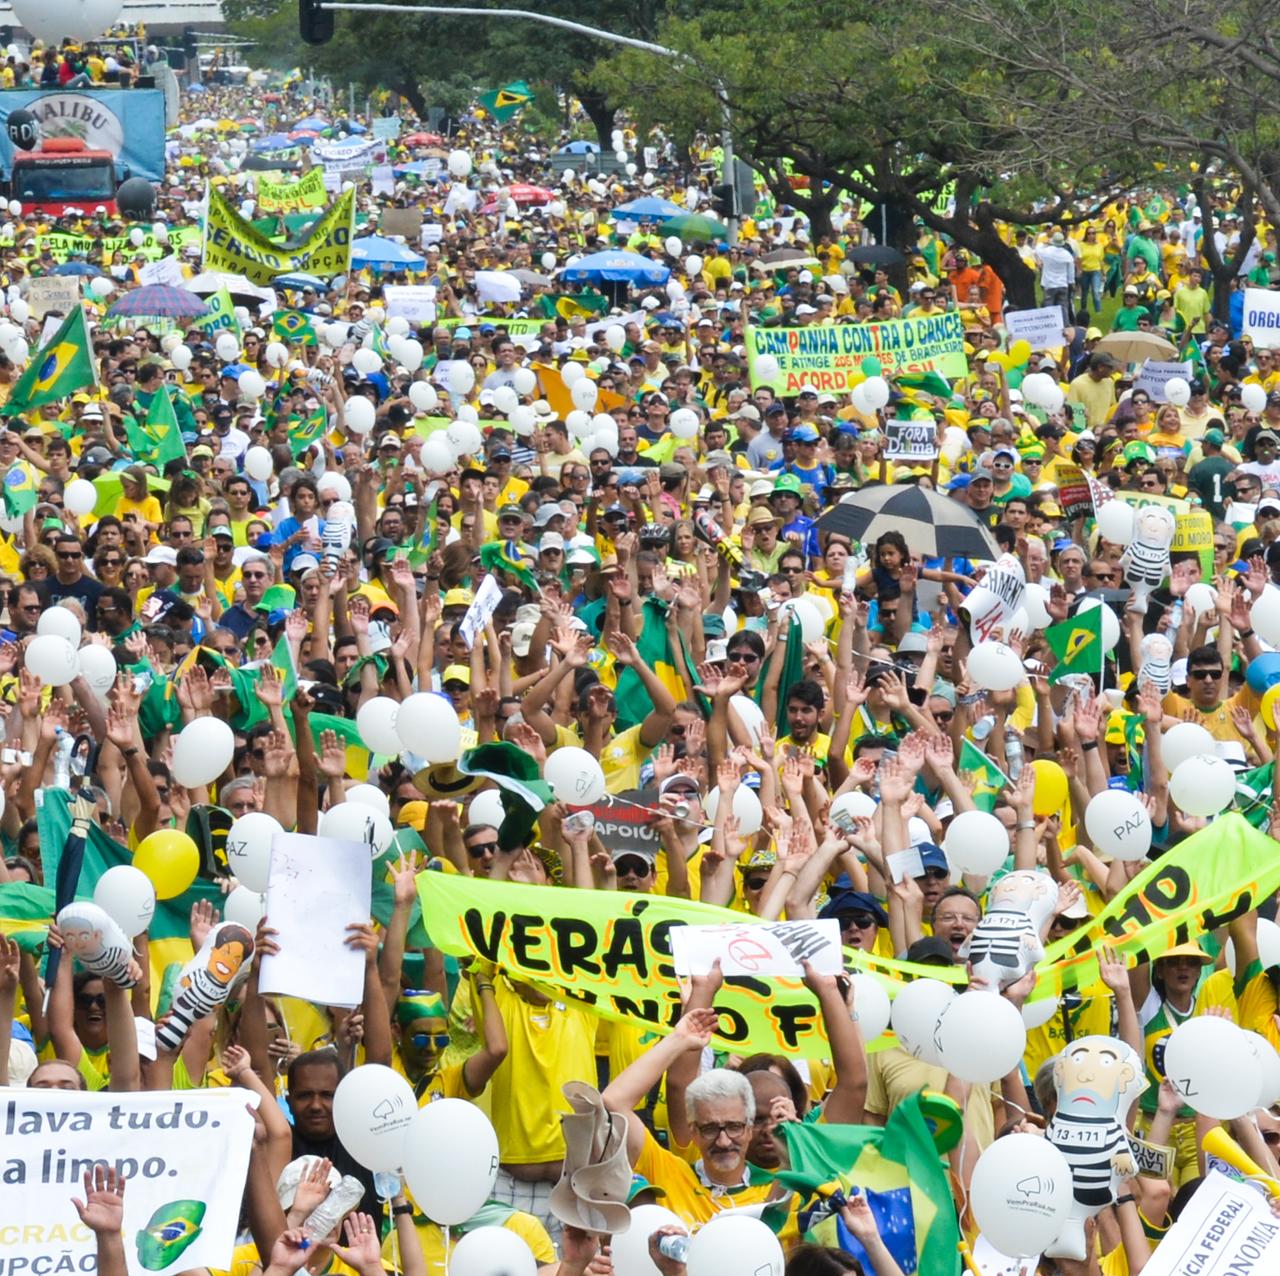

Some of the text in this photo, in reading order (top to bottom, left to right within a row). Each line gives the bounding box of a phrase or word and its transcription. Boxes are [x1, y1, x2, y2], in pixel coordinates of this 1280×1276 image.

[754, 320, 914, 355] CAMPANHA CONTRA O
[791, 356, 831, 370] ATINGE
[834, 354, 848, 367] 205
[896, 351, 907, 363] DE
[786, 371, 846, 391] ACORD
[900, 427, 928, 442] FORA
[1112, 811, 1144, 841] PAZ
[4, 1100, 93, 1137] lava
[108, 1102, 221, 1129] tudo.
[2, 1160, 25, 1184] a
[41, 1146, 178, 1186] limpo.
[1200, 1199, 1244, 1250] FEDERAL
